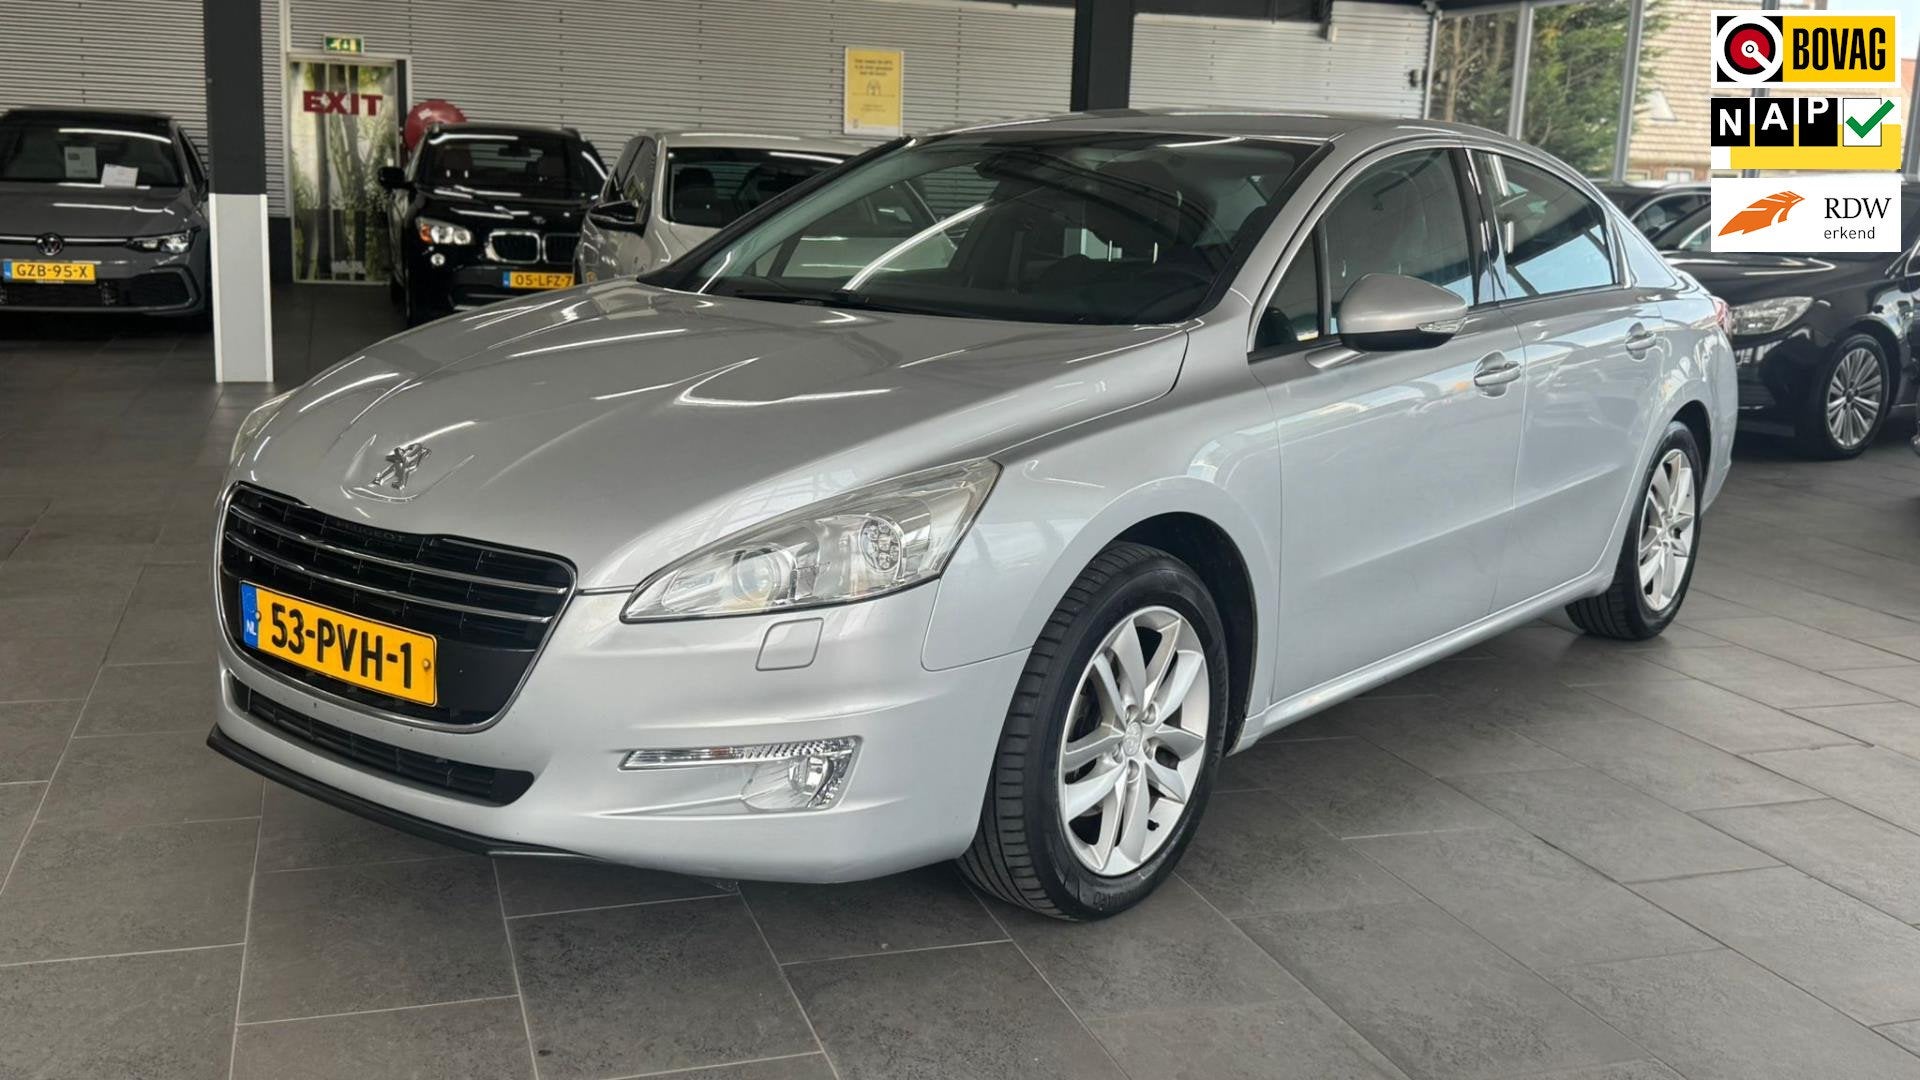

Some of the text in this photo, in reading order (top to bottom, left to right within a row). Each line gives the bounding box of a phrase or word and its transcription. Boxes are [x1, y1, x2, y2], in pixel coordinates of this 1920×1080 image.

[303, 90, 384, 116] EXIT
[16, 263, 88, 278] GZB-95-X
[515, 273, 572, 287] 05-LFZ-7
[246, 620, 257, 635] NL
[271, 602, 412, 690] 53-PVH-1
